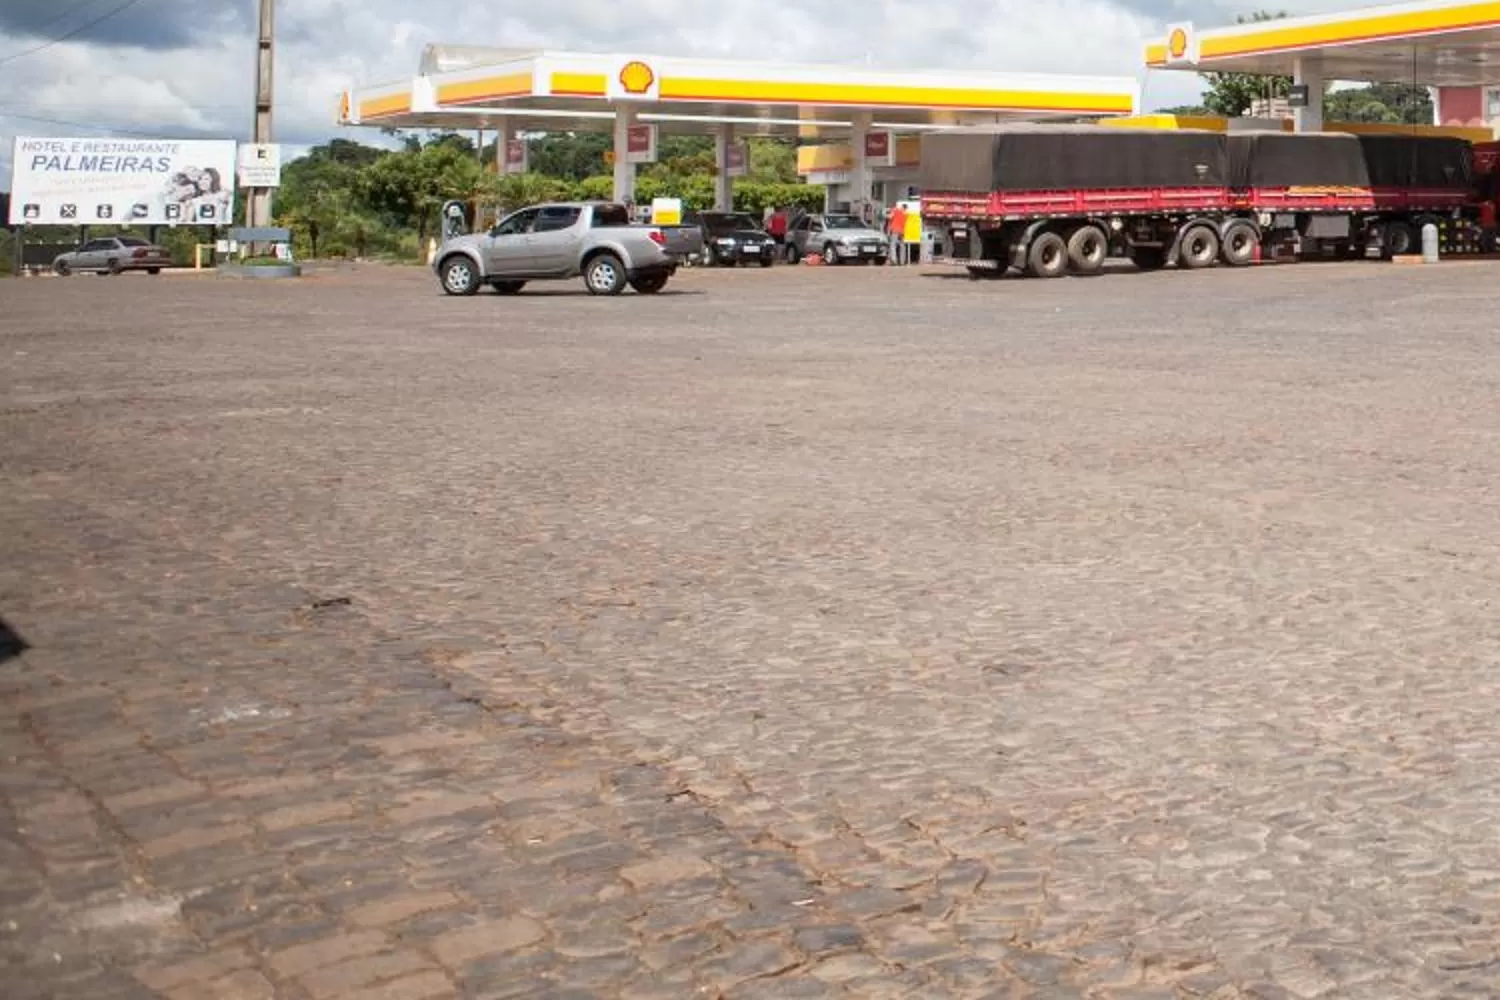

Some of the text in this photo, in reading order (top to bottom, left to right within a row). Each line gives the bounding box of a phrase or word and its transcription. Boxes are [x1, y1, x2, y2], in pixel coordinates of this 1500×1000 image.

[22, 141, 181, 154] HOTEL E RESTAURANTE
[31, 154, 171, 172] PALMEIRAS
